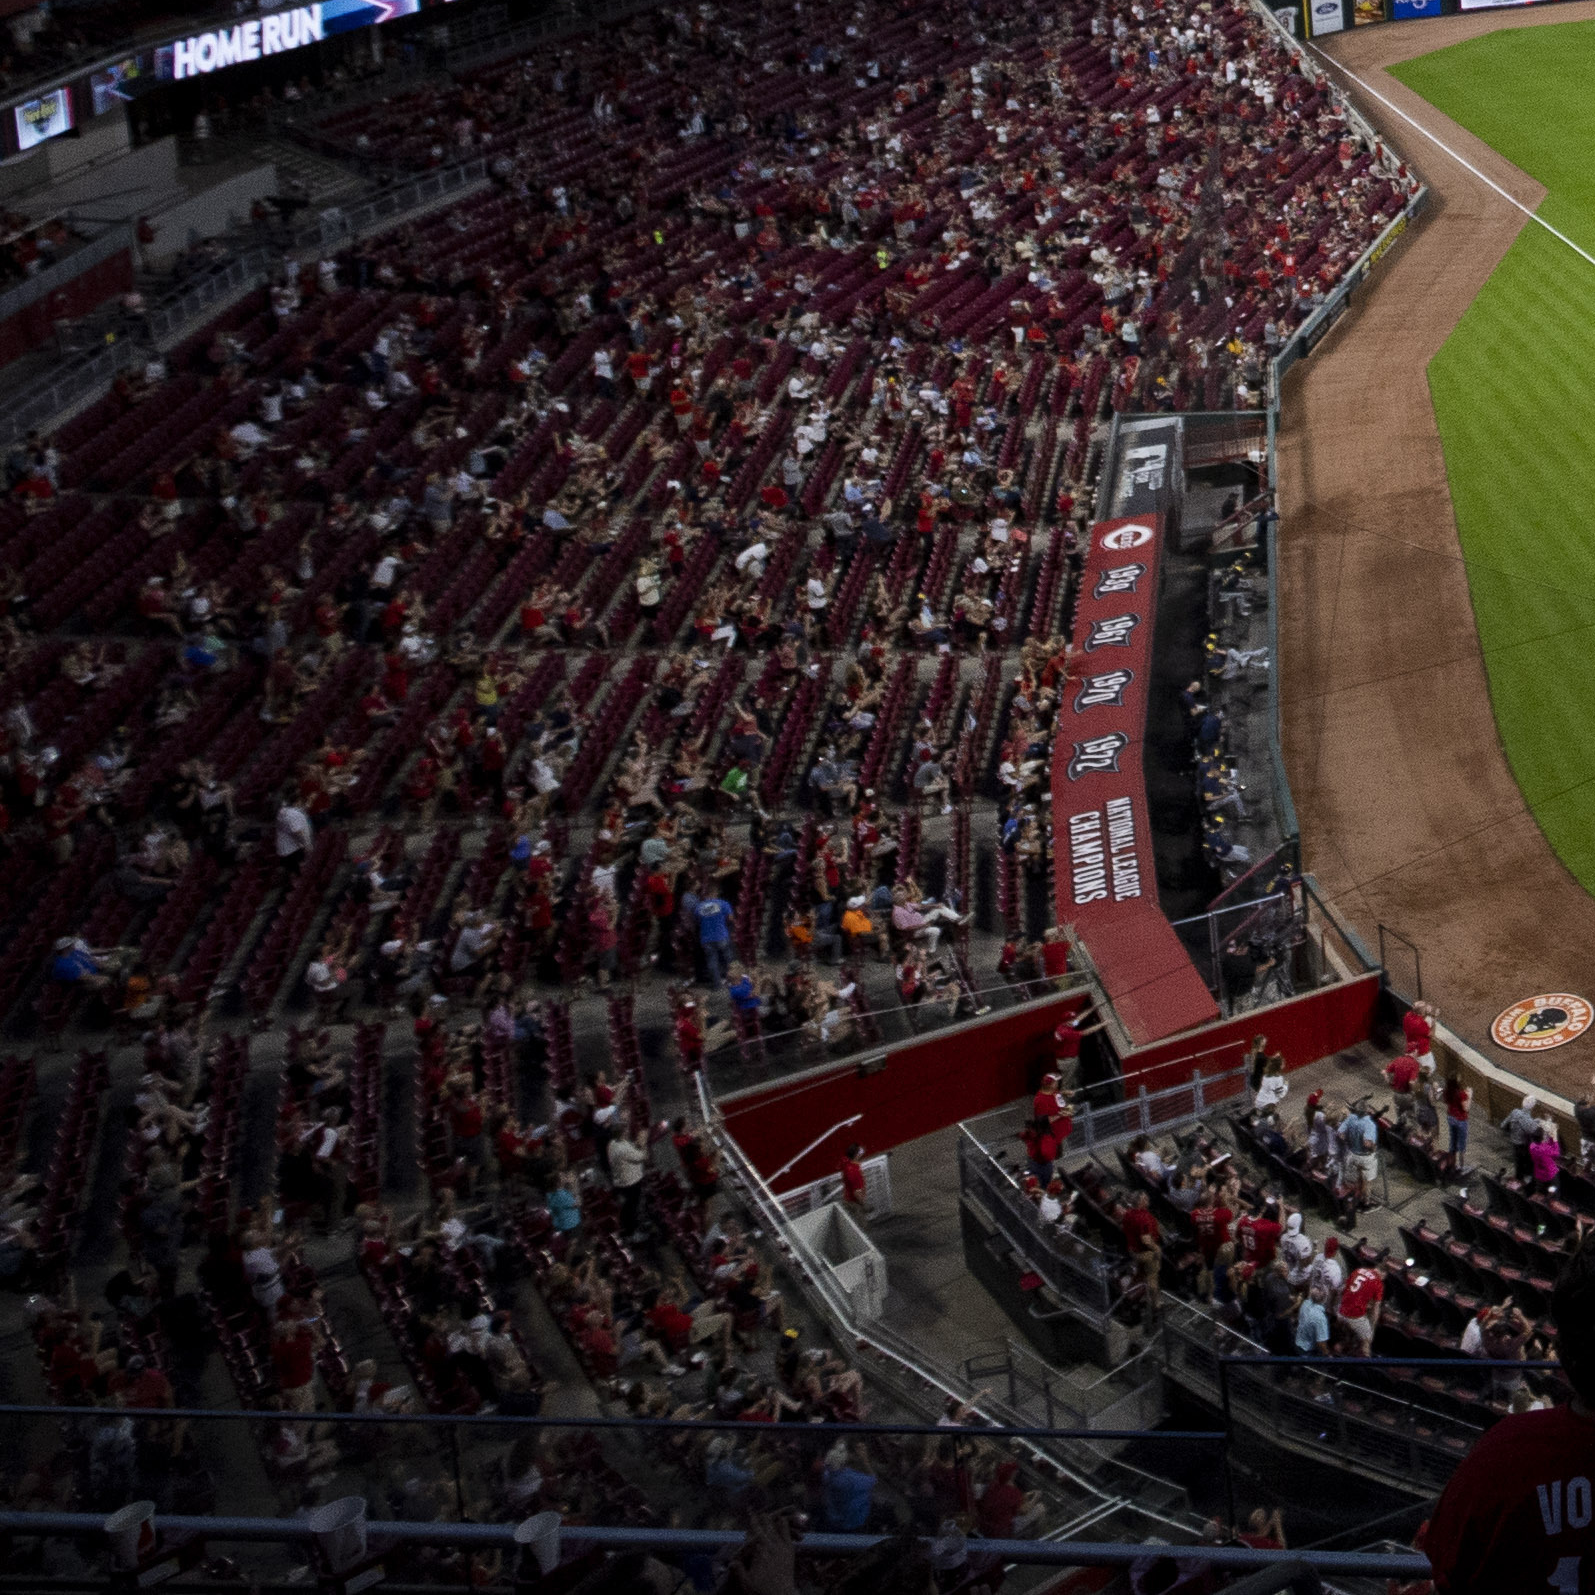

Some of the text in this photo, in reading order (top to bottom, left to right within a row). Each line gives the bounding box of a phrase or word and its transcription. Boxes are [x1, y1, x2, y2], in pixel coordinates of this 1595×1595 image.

[173, 4, 323, 80] HOME RUN
[1092, 615, 1134, 645] 1961
[1081, 671, 1128, 705] 1970
[1075, 734, 1122, 772] 1972
[1068, 810, 1108, 905] CHAMPIONS
[1105, 795, 1142, 902] NATIONAL LEAGUE
[1533, 995, 1589, 1033] BUFFALO
[1516, 1034, 1565, 1048] RINGS
[1349, 1276, 1366, 1294] 5
